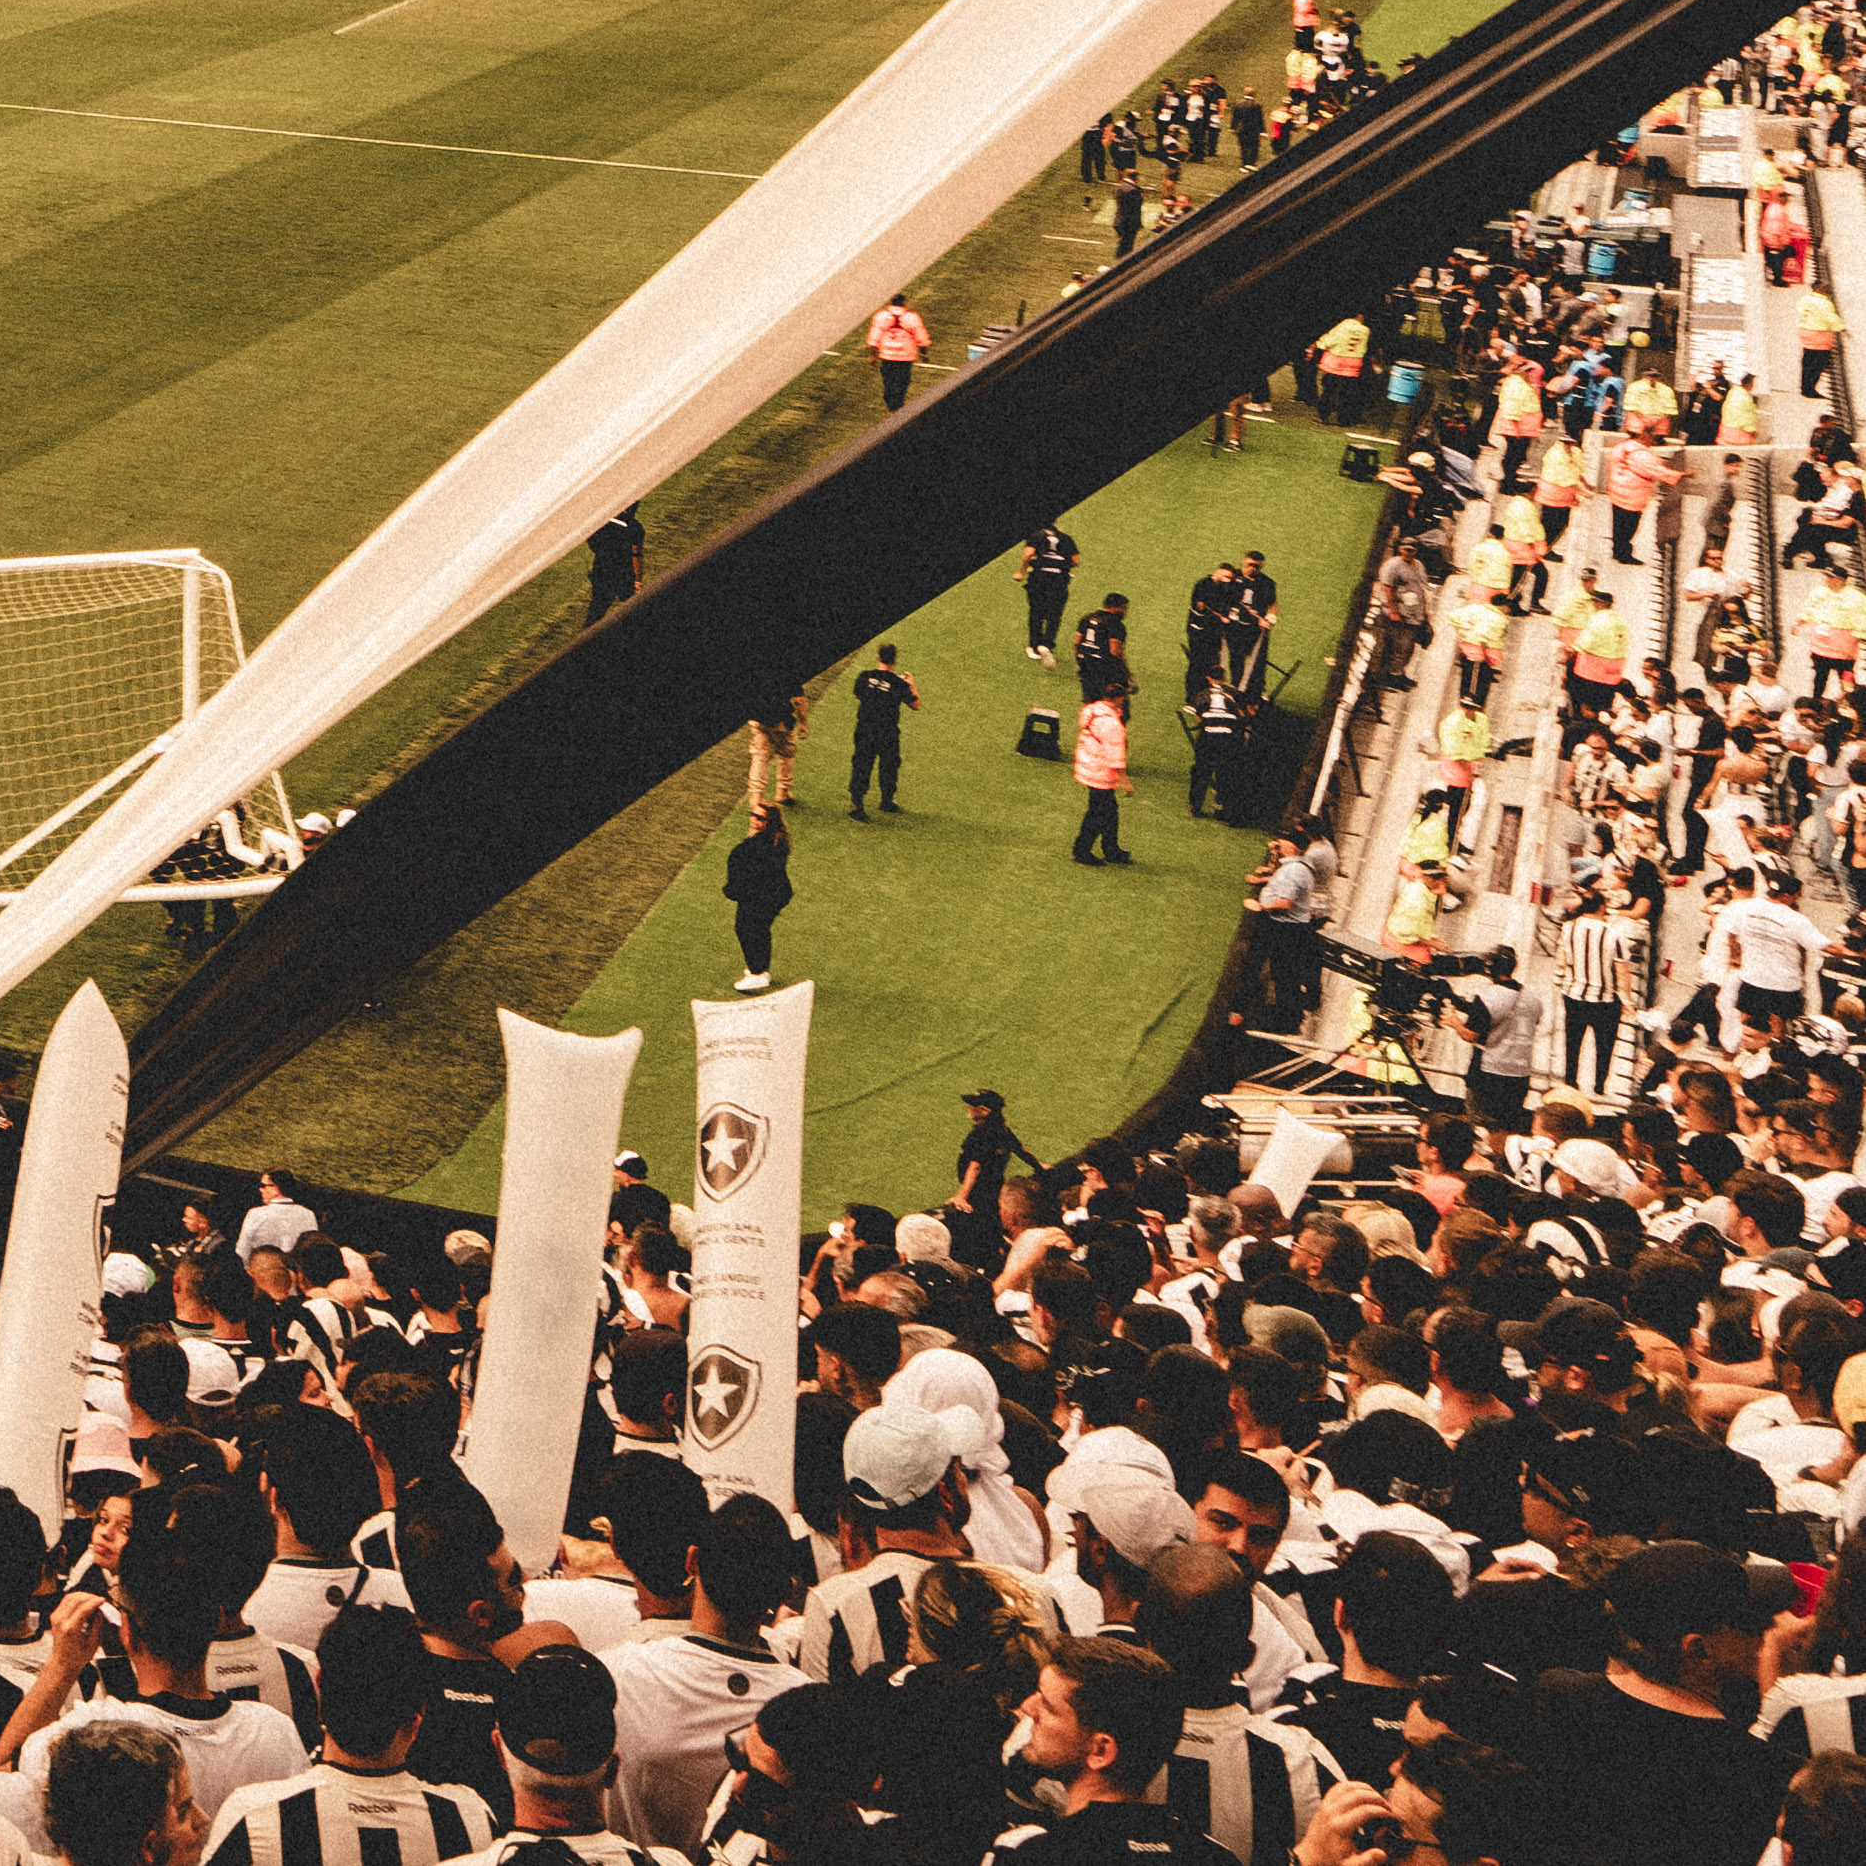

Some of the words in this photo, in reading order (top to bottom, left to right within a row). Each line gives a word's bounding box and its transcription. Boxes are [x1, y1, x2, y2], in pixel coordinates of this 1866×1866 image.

[214, 1663, 259, 1676] Reebok
[443, 1688, 495, 1705] Reebok
[347, 1802, 398, 1815] Reebok
